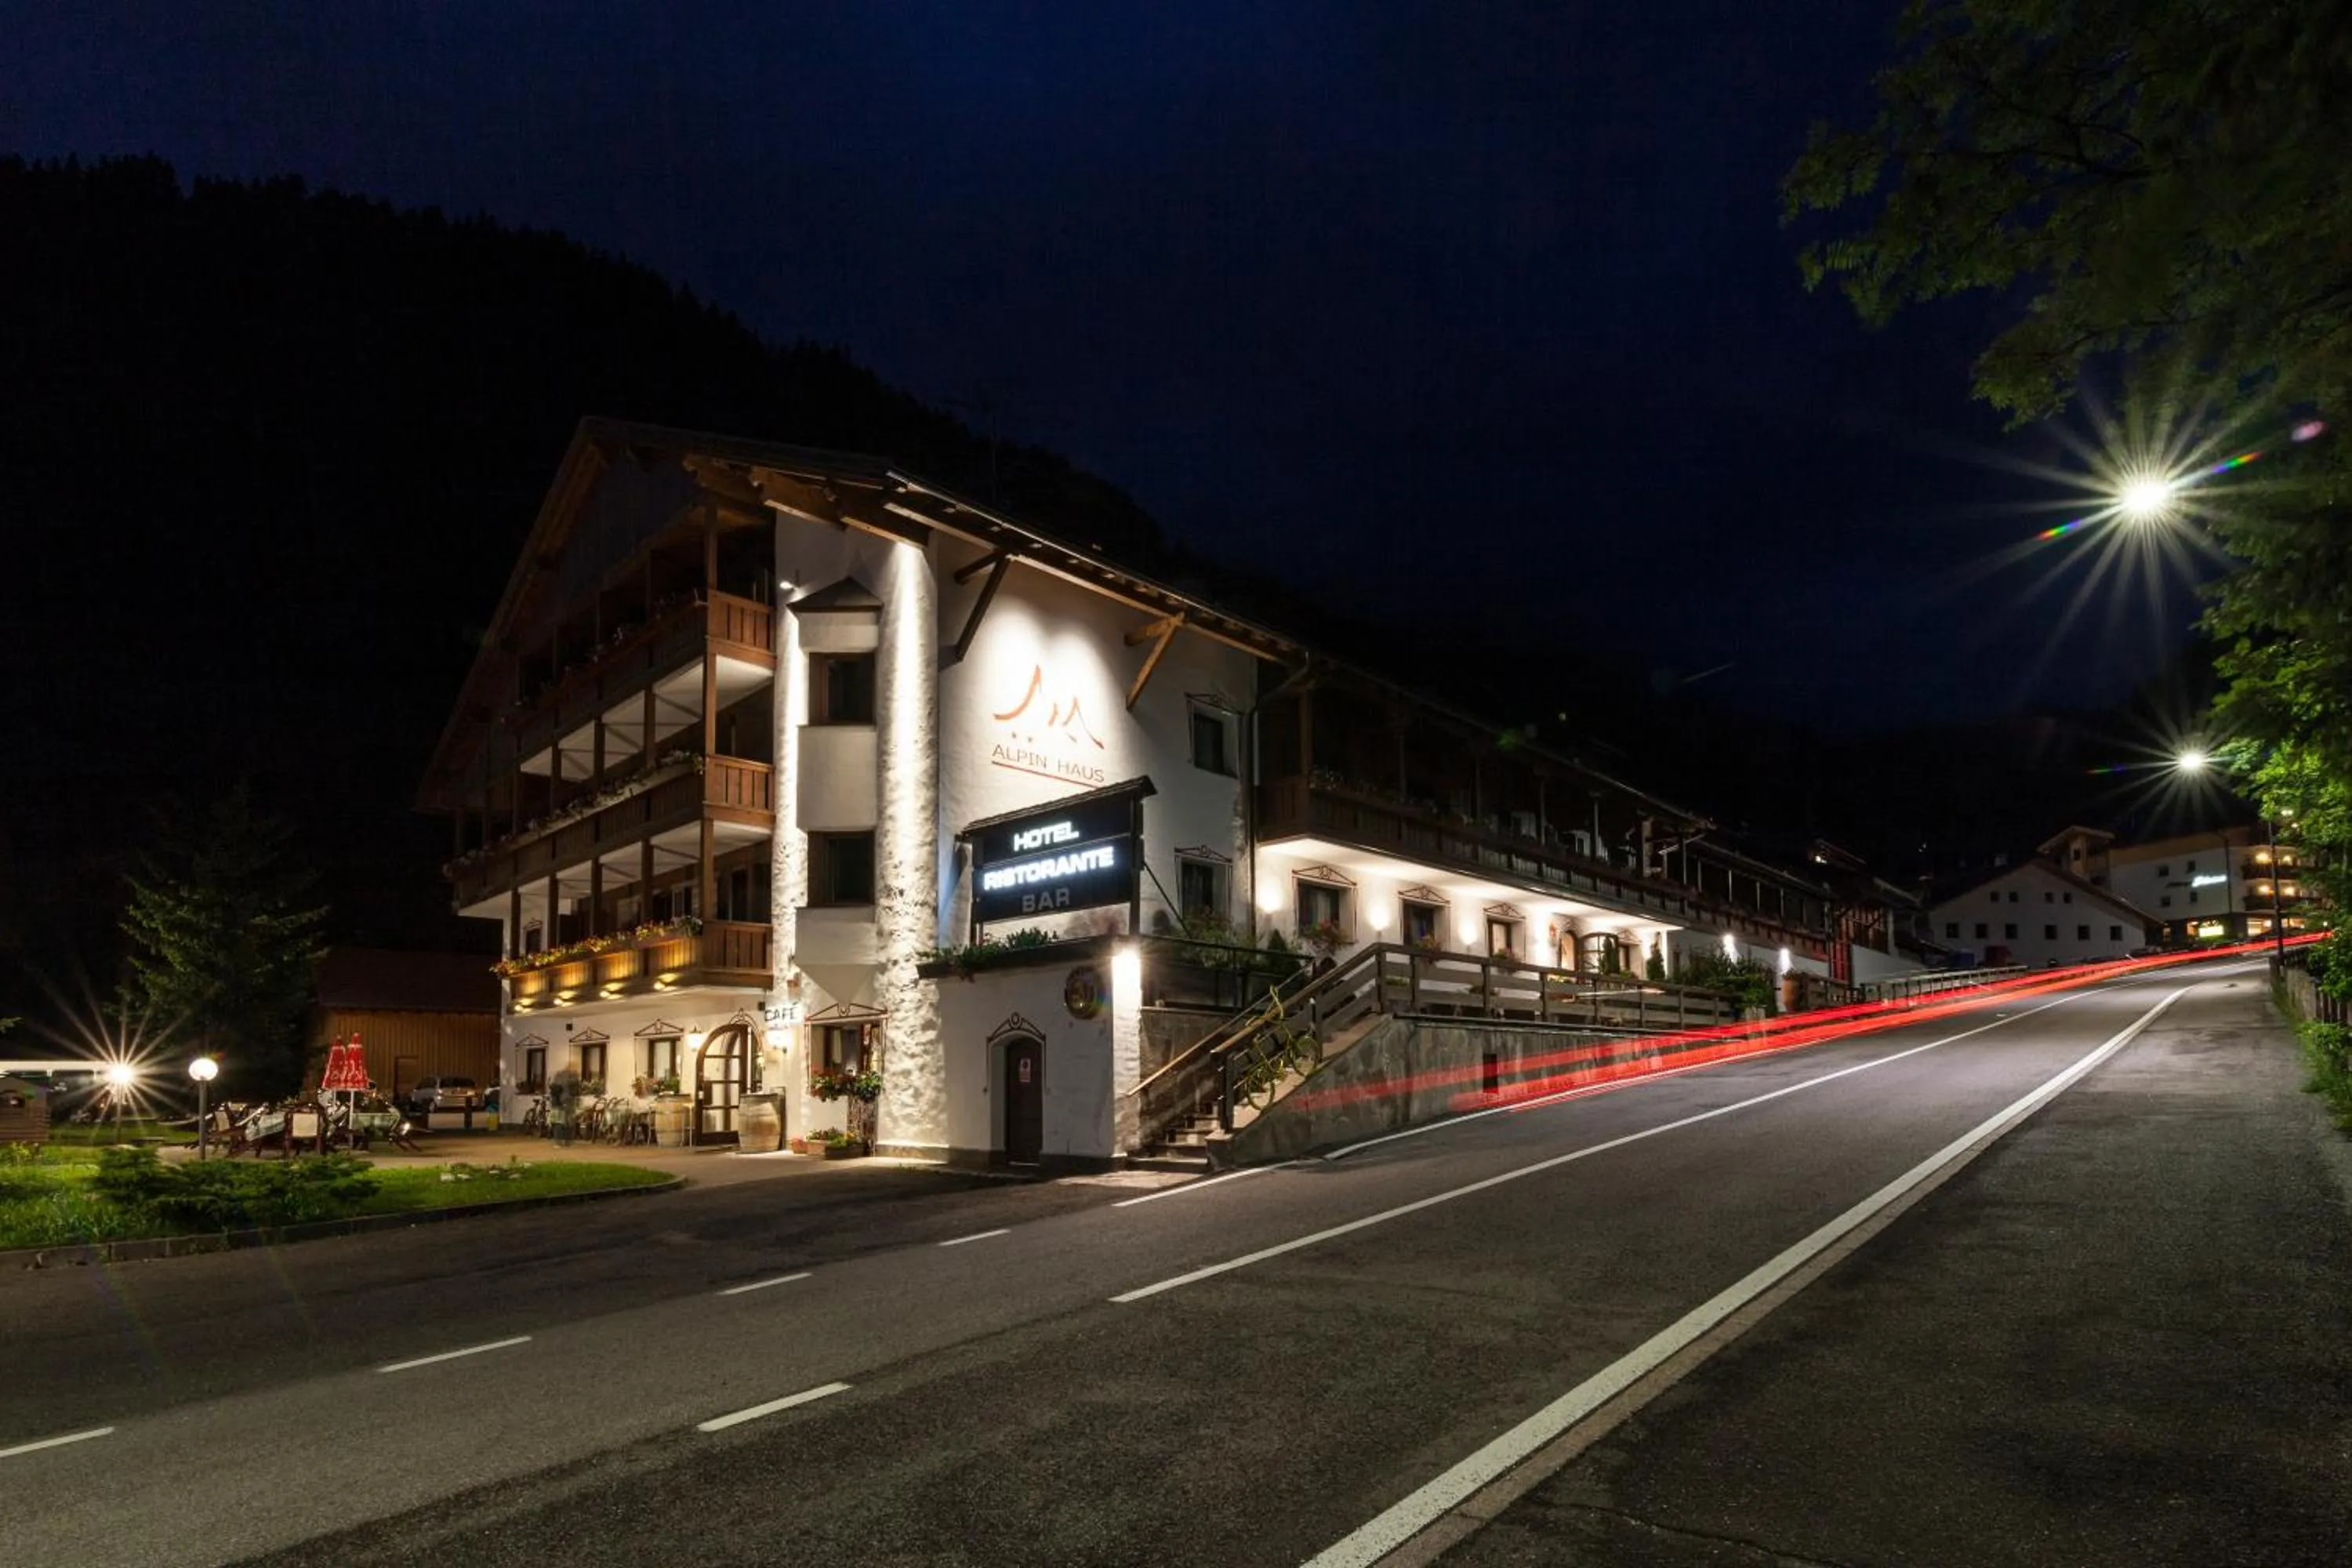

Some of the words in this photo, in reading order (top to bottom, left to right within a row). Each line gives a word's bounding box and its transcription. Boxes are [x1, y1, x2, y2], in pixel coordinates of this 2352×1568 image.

[992, 743, 1047, 769] ALPIN
[1058, 757, 1105, 782] HAUS
[1014, 821, 1080, 851] HOTEL
[984, 846, 1114, 891] RISTORANTE
[1022, 887, 1069, 913] BAR
